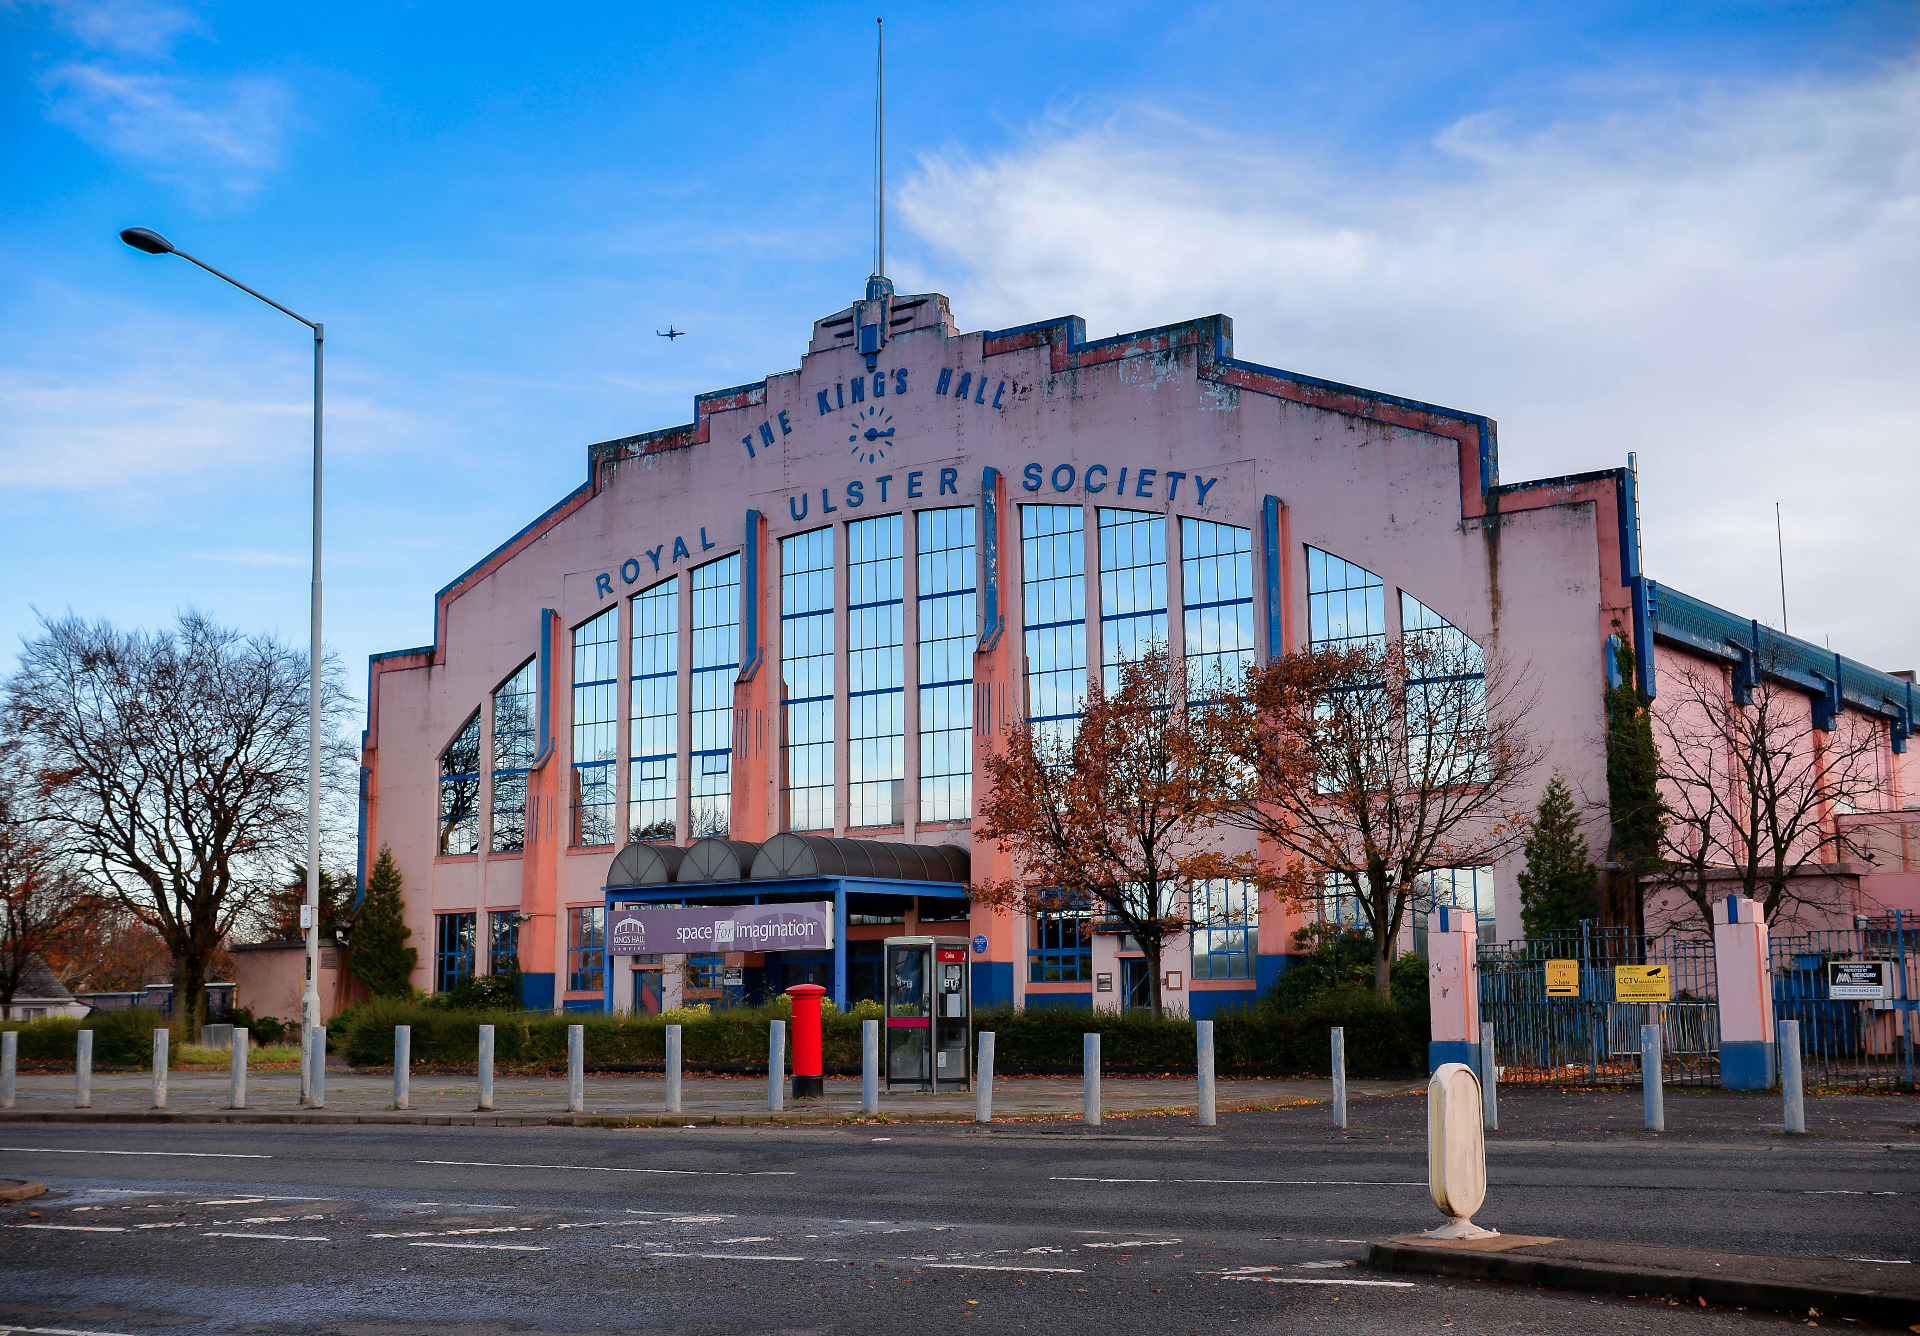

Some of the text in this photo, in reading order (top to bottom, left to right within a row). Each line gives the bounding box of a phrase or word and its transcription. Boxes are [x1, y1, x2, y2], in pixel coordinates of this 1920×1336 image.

[742, 368, 1006, 458] THE KING'S HALL
[596, 463, 1217, 598] ROYAL ULSTER SOCIETY
[676, 924, 712, 944] space
[715, 922, 734, 942] for
